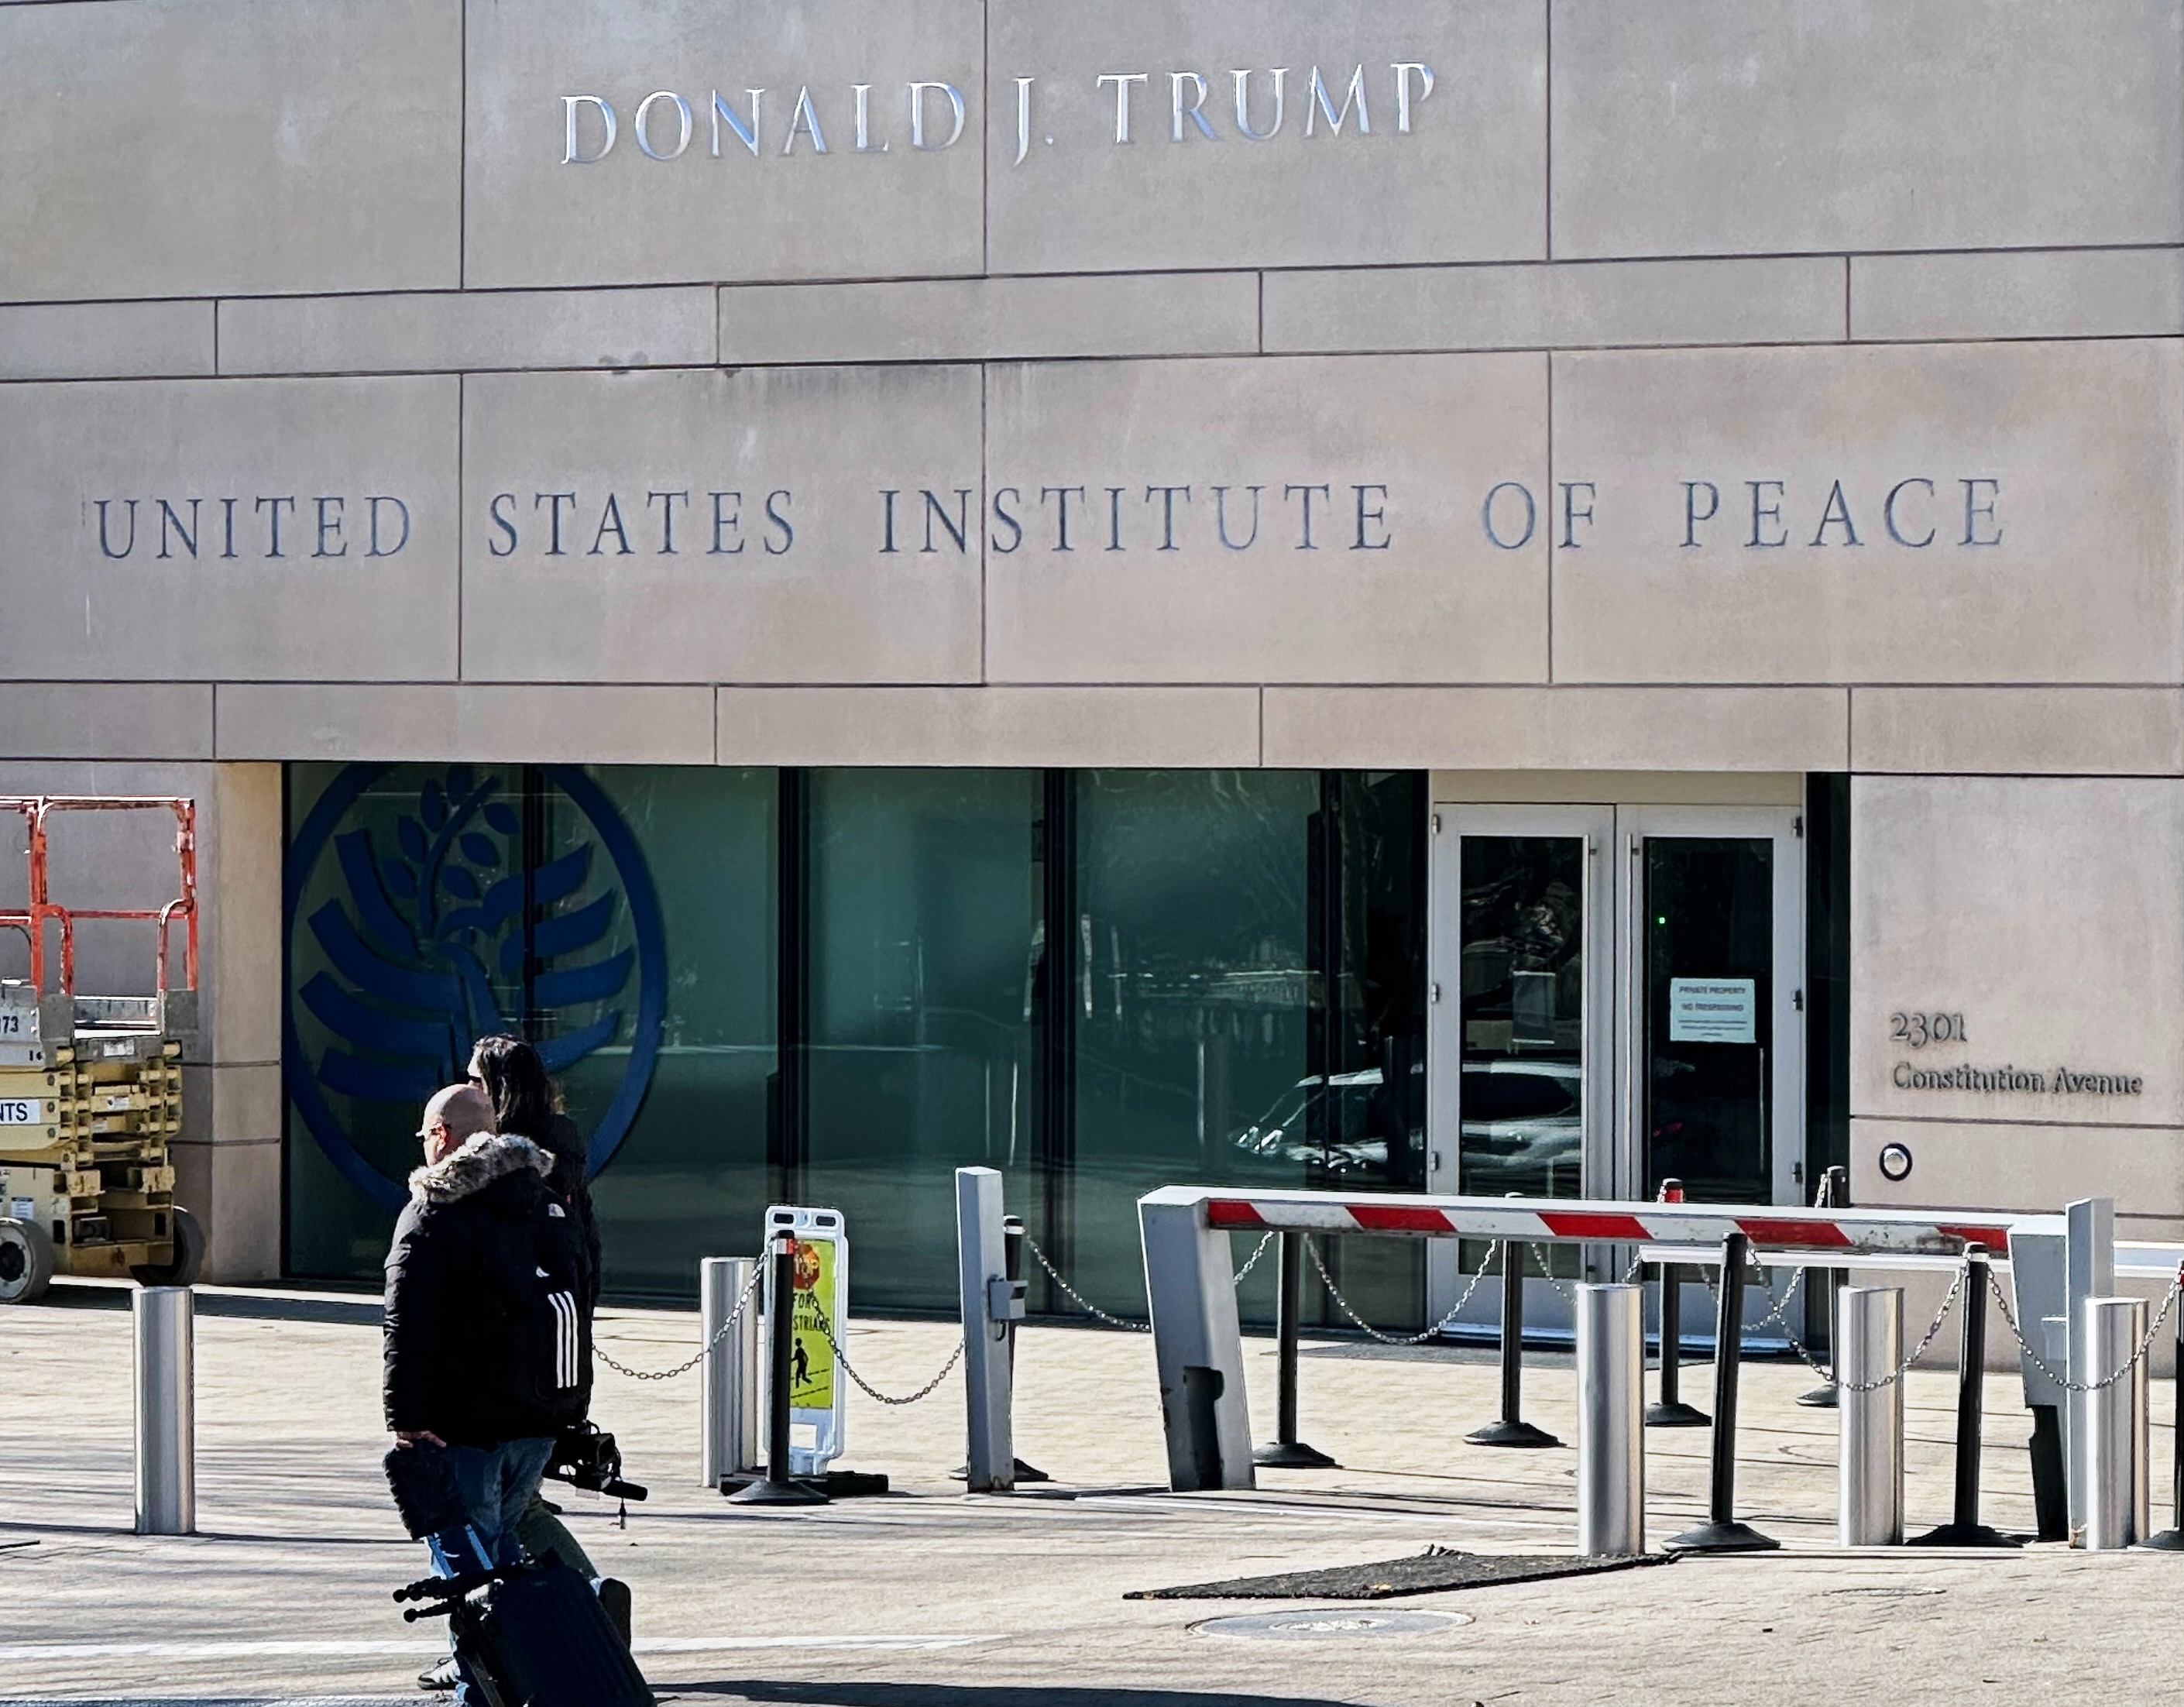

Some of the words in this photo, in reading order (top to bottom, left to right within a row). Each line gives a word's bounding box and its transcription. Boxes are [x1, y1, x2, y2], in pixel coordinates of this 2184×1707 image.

[561, 81, 966, 164] DONALD
[1013, 77, 1055, 167] J.
[1096, 63, 1434, 144] TRUMP
[93, 496, 411, 559] UNITED
[488, 490, 795, 557] STATES
[878, 483, 1392, 554] INSTITUTE
[1482, 481, 1597, 549] OF
[1678, 477, 2004, 548] PEACE
[0, 1015, 19, 1034] 73
[1890, 1011, 1968, 1049] 2301
[1893, 1061, 2046, 1094] Constitution
[2052, 1066, 2144, 1096] Avenue
